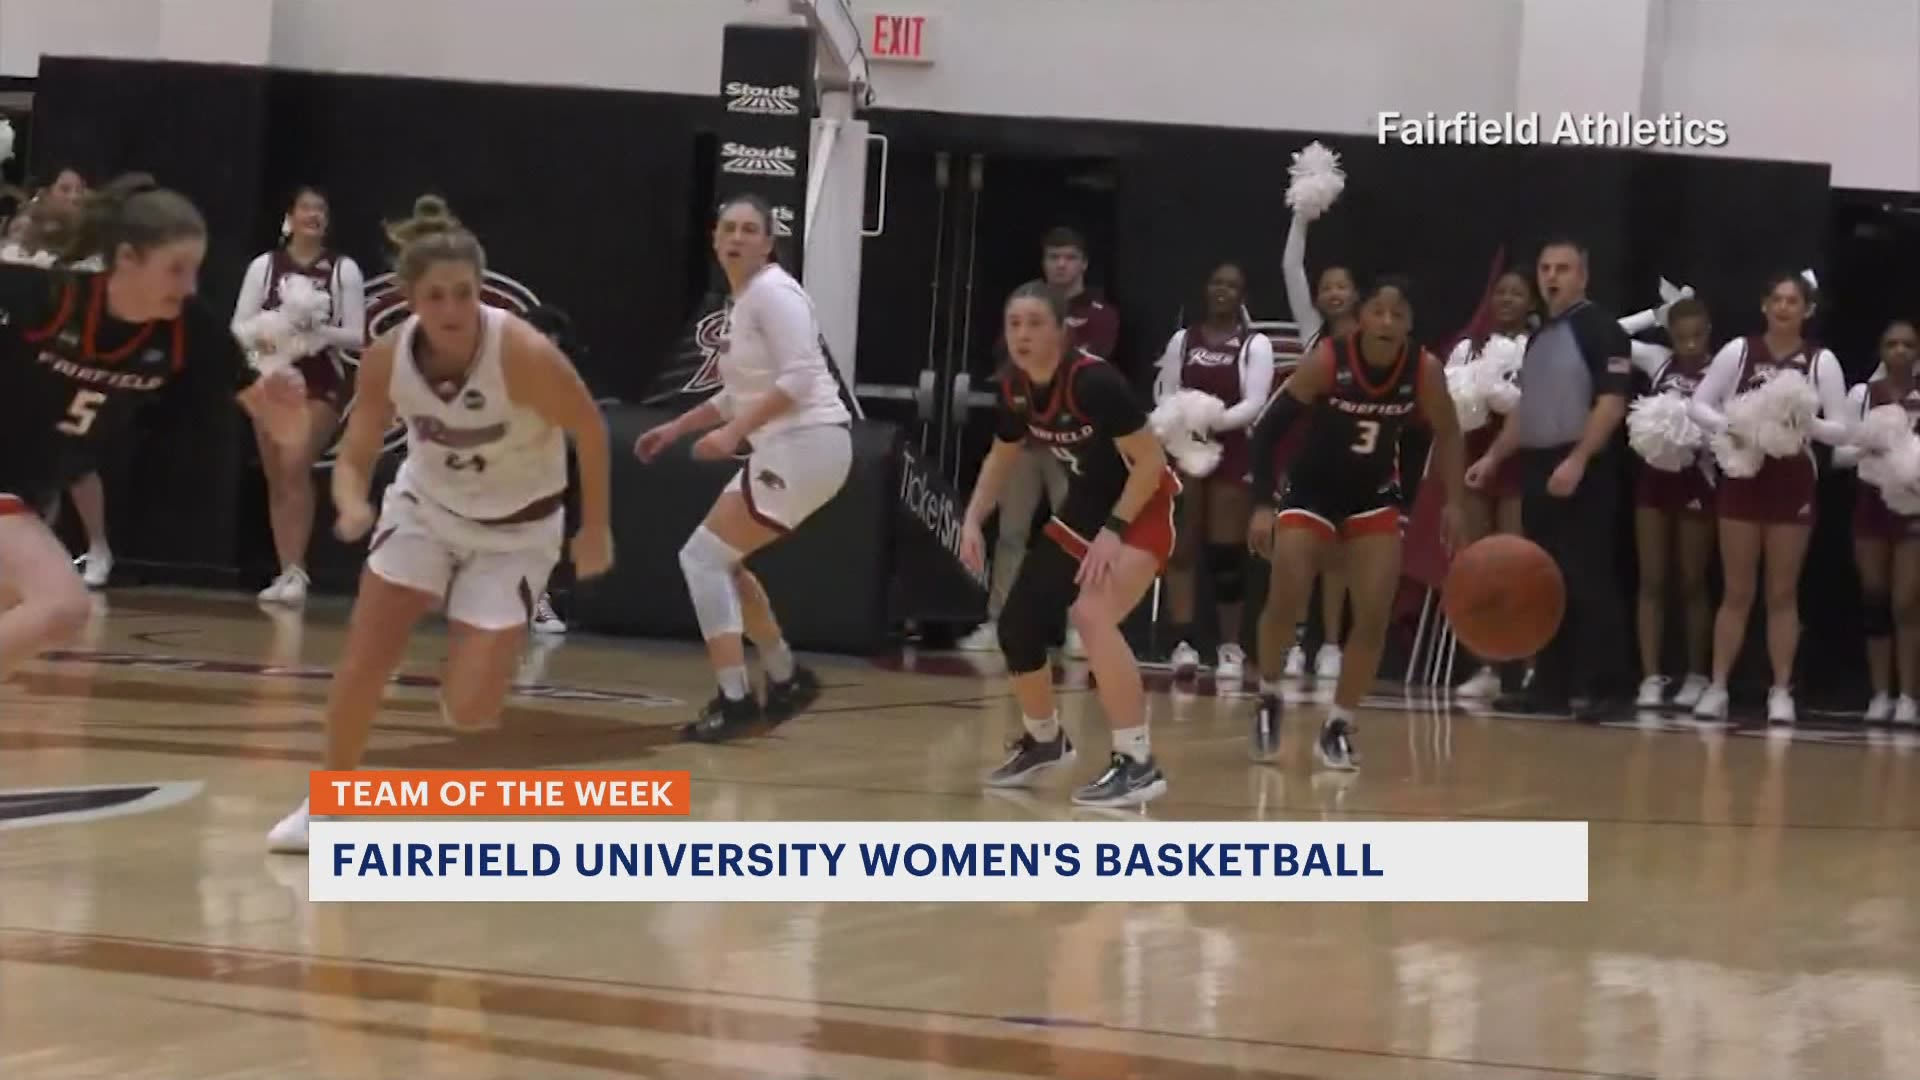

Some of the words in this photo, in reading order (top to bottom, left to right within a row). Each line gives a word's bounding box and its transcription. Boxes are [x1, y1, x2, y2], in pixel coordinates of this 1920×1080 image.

[873, 15, 926, 57] EXIT
[56, 388, 107, 436] 5
[1351, 420, 1380, 454] 3
